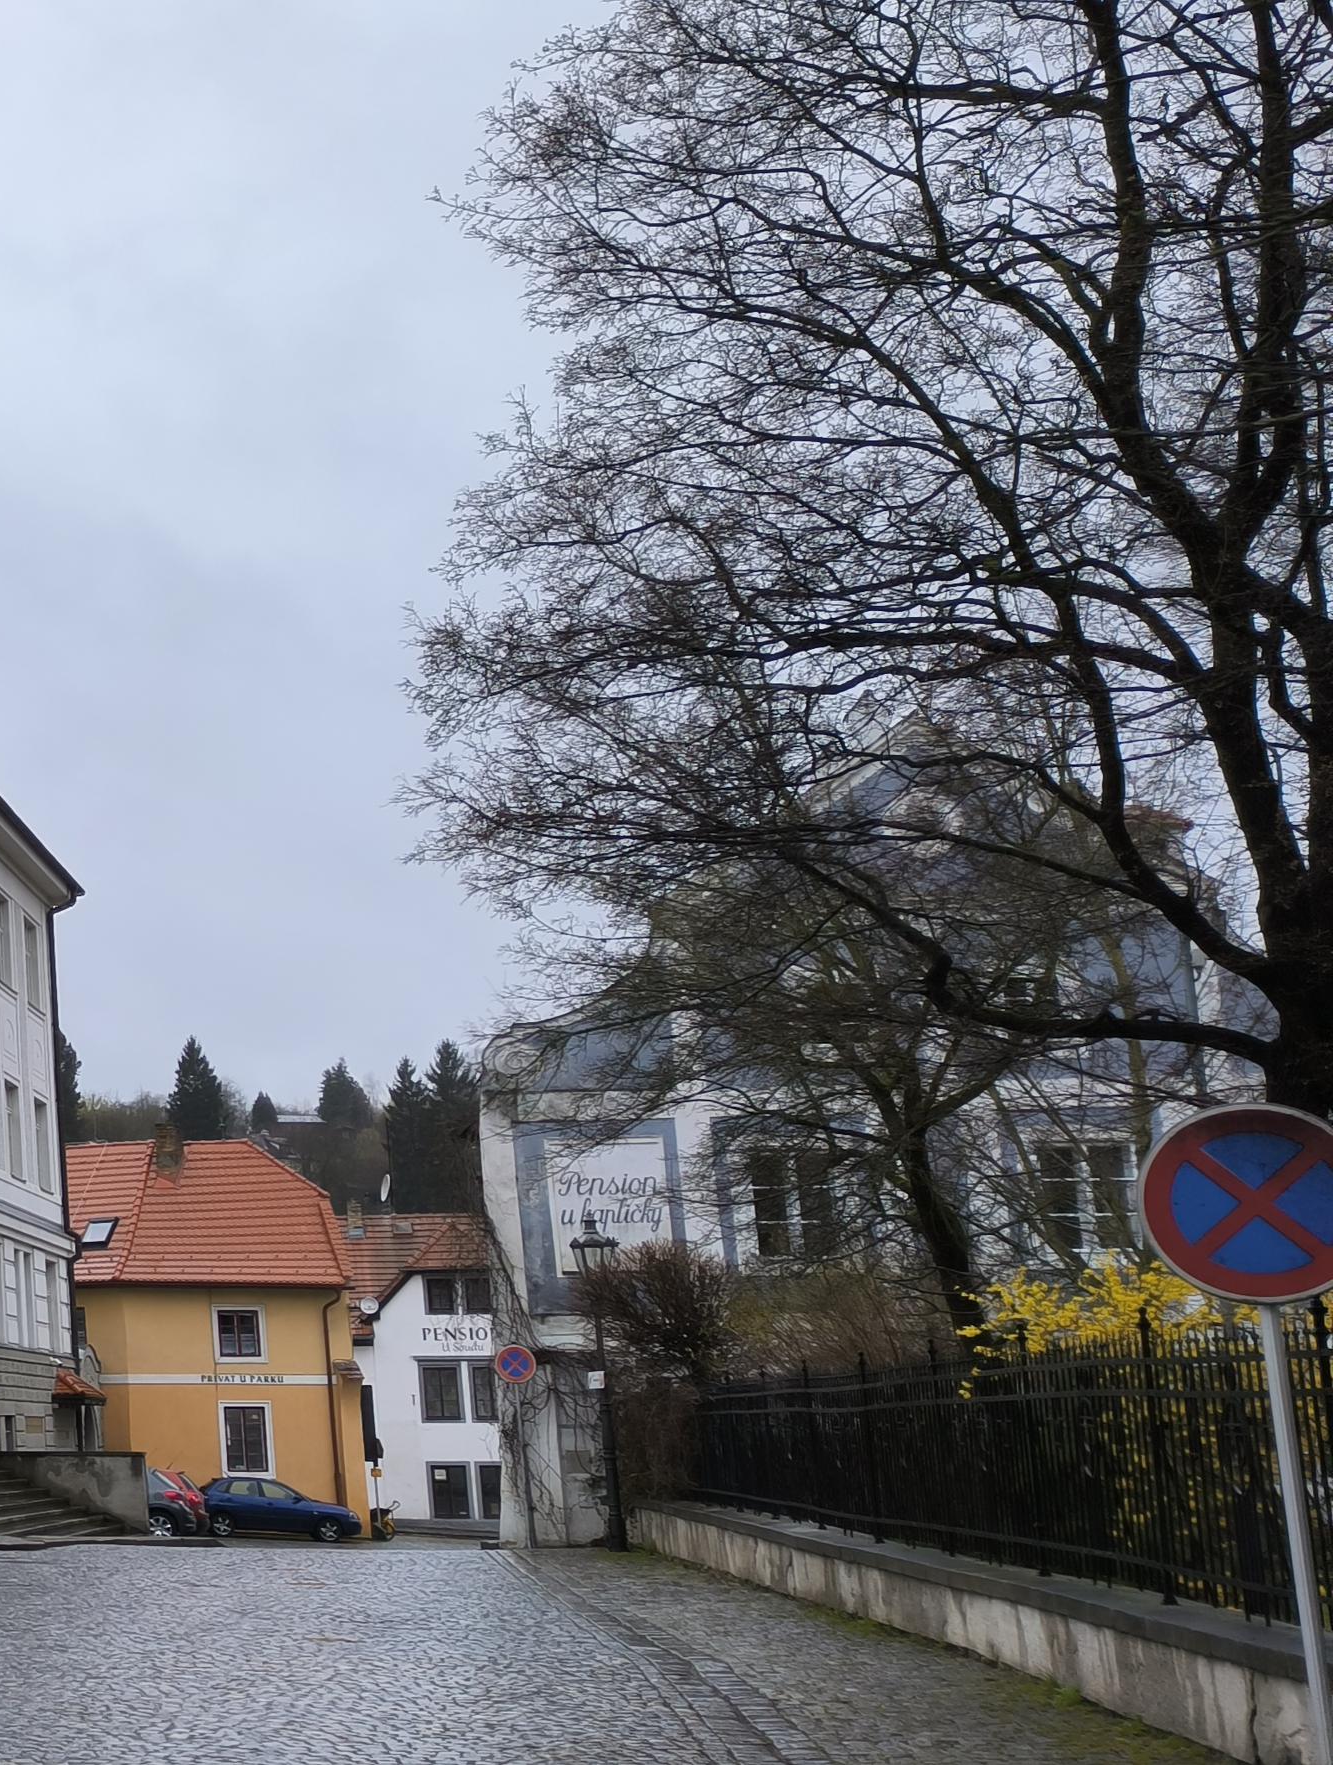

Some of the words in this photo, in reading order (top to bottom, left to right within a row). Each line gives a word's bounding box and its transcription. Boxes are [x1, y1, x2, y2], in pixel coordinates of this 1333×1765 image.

[558, 1171, 657, 1197] Pension
[560, 1207, 576, 1225] u
[421, 1327, 494, 1341] PENSIO
[441, 1342, 451, 1352] U
[240, 1375, 247, 1383] U
[250, 1375, 284, 1383] PARKU
